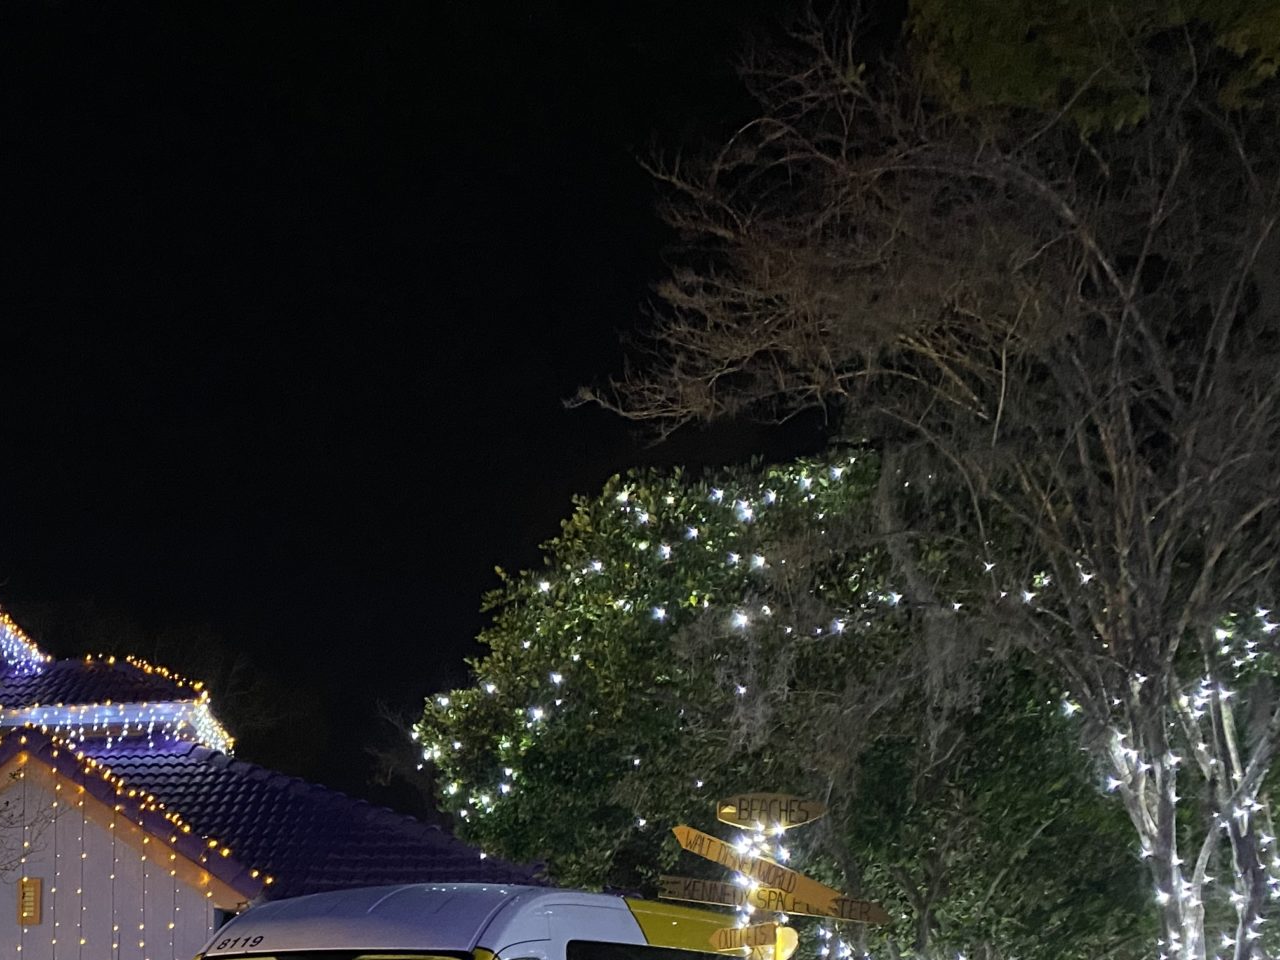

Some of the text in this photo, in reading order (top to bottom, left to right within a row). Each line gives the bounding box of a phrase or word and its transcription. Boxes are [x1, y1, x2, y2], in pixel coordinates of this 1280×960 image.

[738, 800, 809, 822] BEACHES
[685, 831, 712, 851] WALT
[758, 863, 797, 894] WORLD
[683, 878, 749, 905] KENNEDY
[756, 889, 804, 913] SPACE
[216, 935, 265, 950] 8119
[720, 925, 768, 949] OUTLETS
